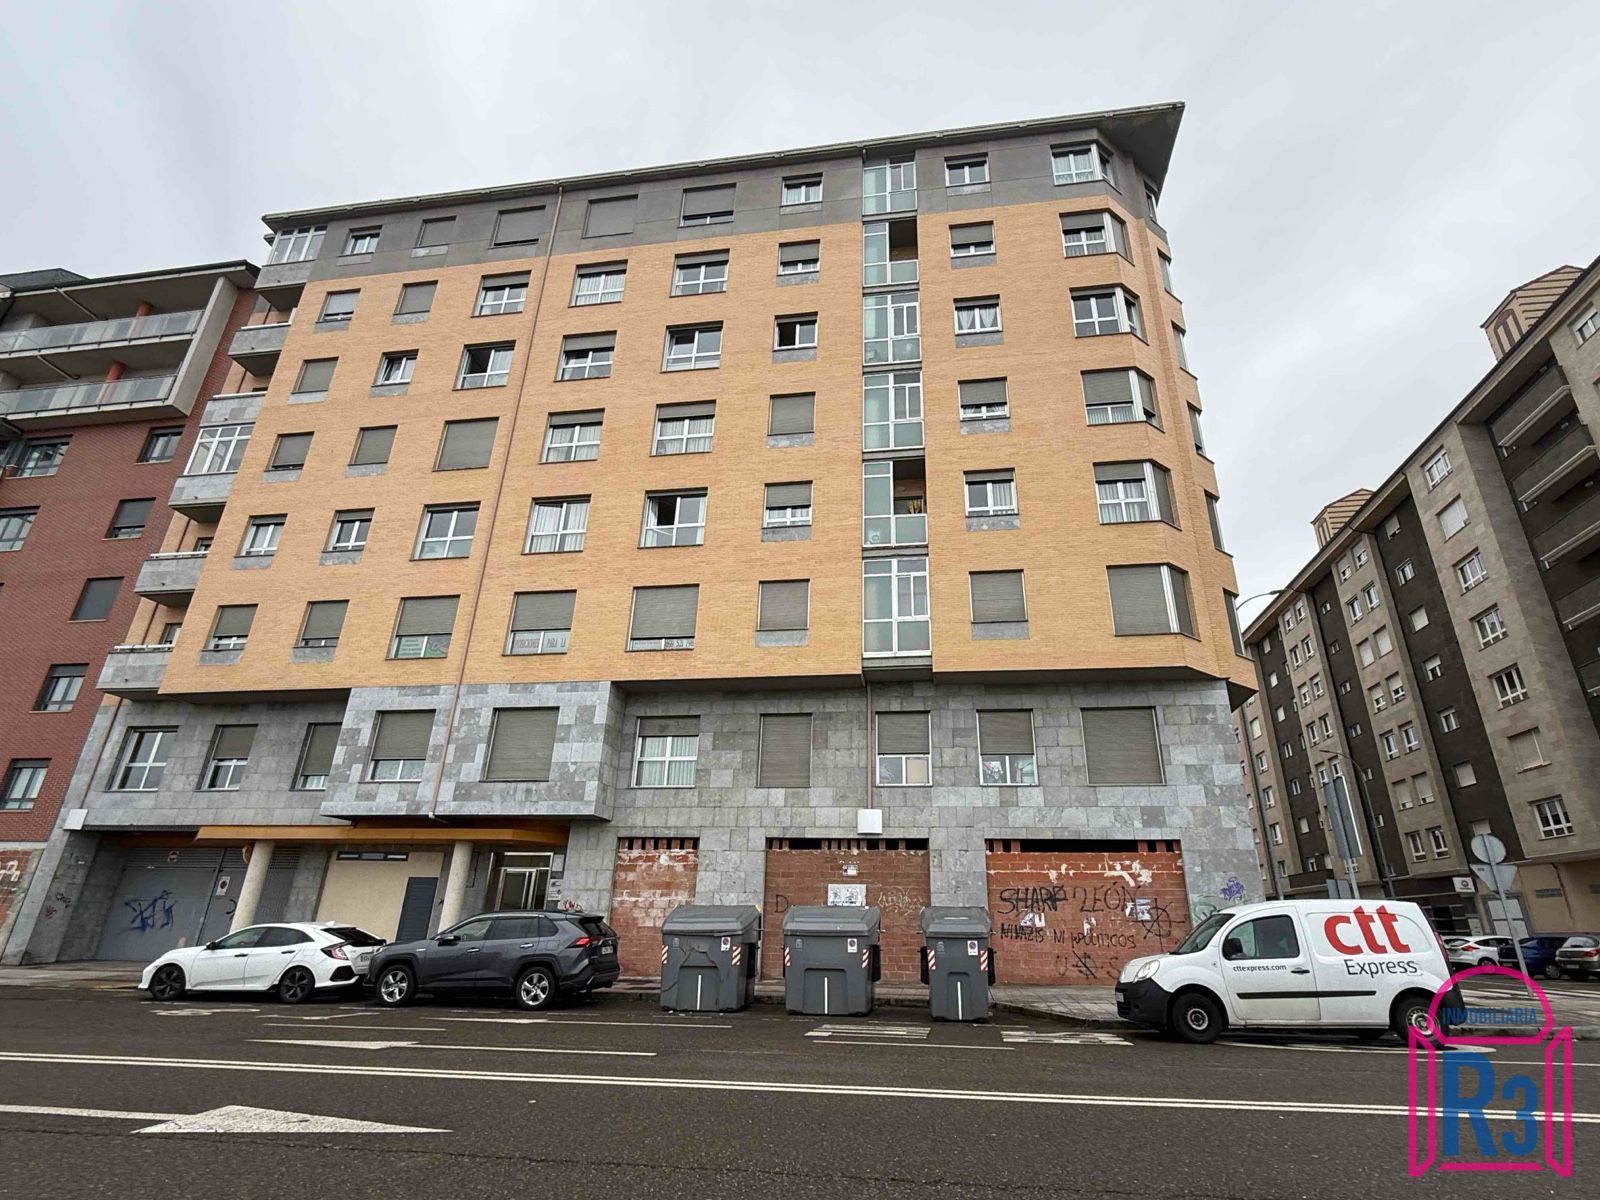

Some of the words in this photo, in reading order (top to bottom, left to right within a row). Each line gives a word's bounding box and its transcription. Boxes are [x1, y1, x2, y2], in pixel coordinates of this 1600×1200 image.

[1053, 929, 1065, 945] NI
[1324, 904, 1411, 955] ctt
[1232, 964, 1287, 973] cttexpress.com
[1344, 958, 1418, 979] Express
